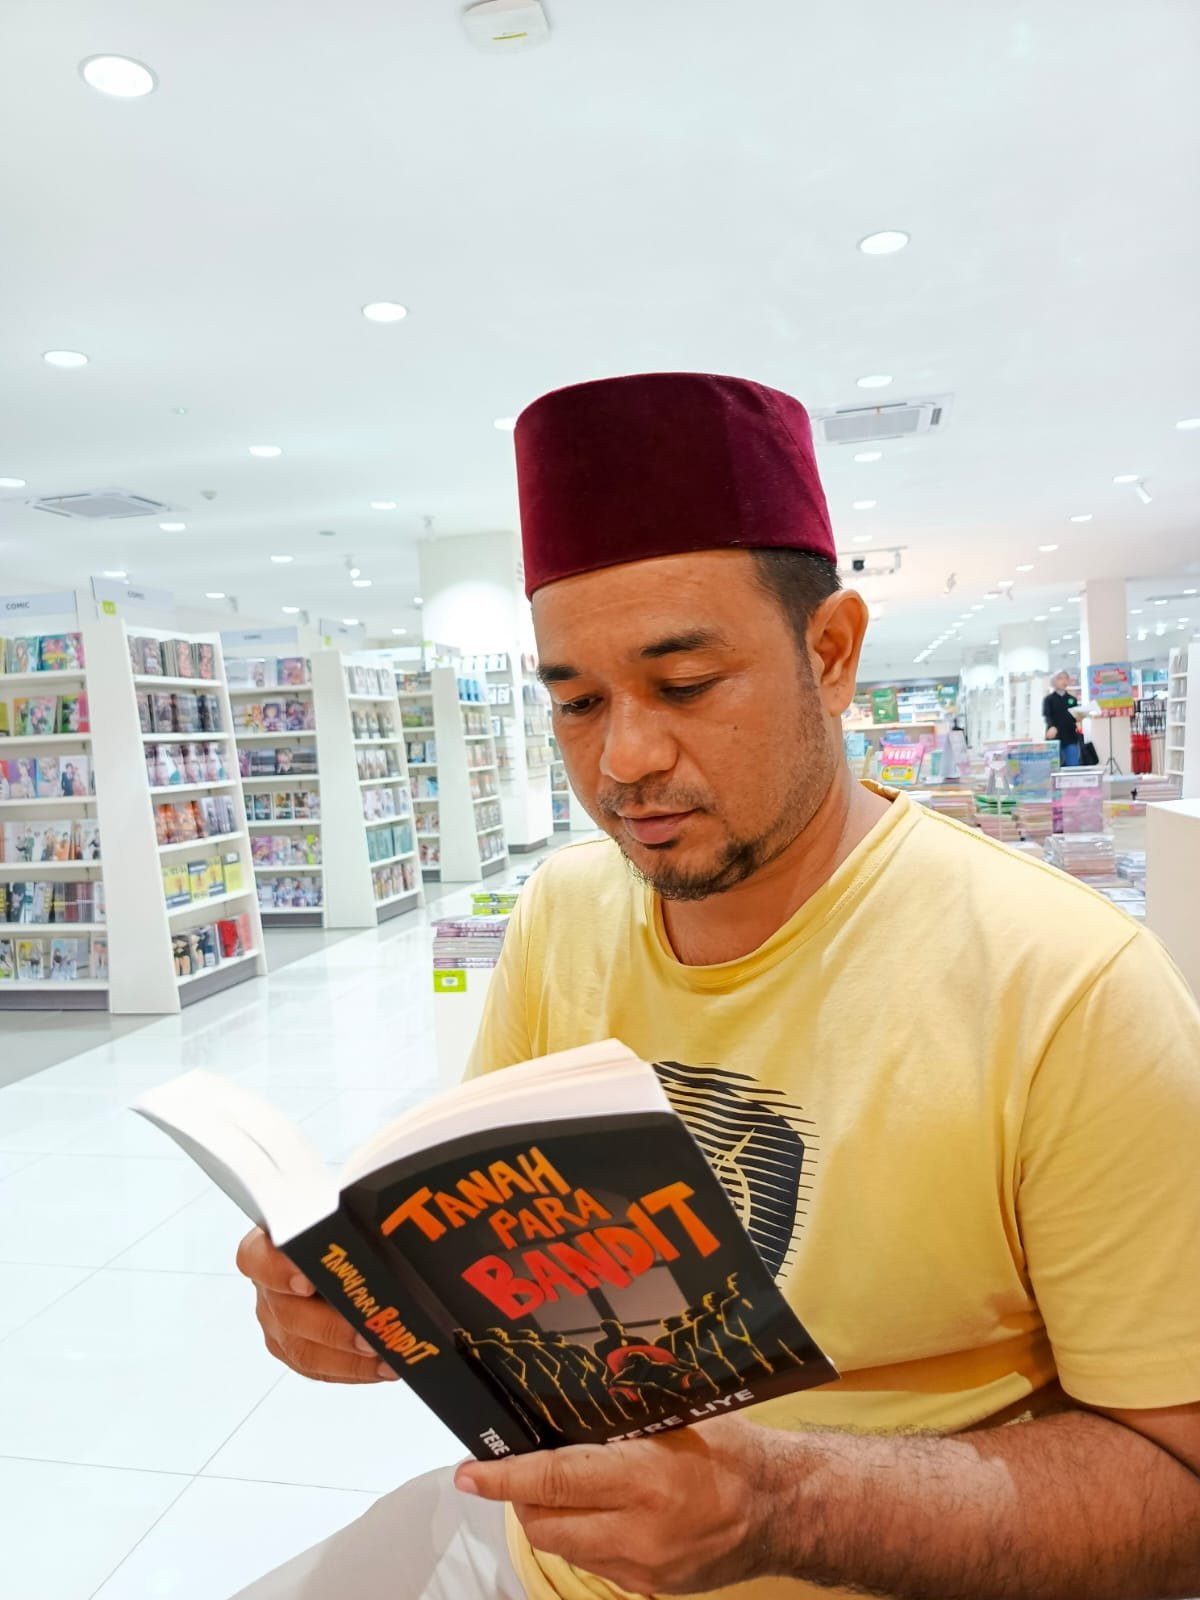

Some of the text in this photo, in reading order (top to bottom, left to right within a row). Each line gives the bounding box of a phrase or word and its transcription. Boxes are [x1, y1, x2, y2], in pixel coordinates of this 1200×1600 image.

[5, 601, 30, 610] COMIC
[381, 1146, 571, 1241] TANAH
[489, 1188, 613, 1249] PARA
[461, 1181, 721, 1320] BANDIT
[321, 1243, 440, 1364] TANAH PARA BANDIT
[690, 1388, 755, 1417] LIYE
[480, 1427, 510, 1455] TERE
